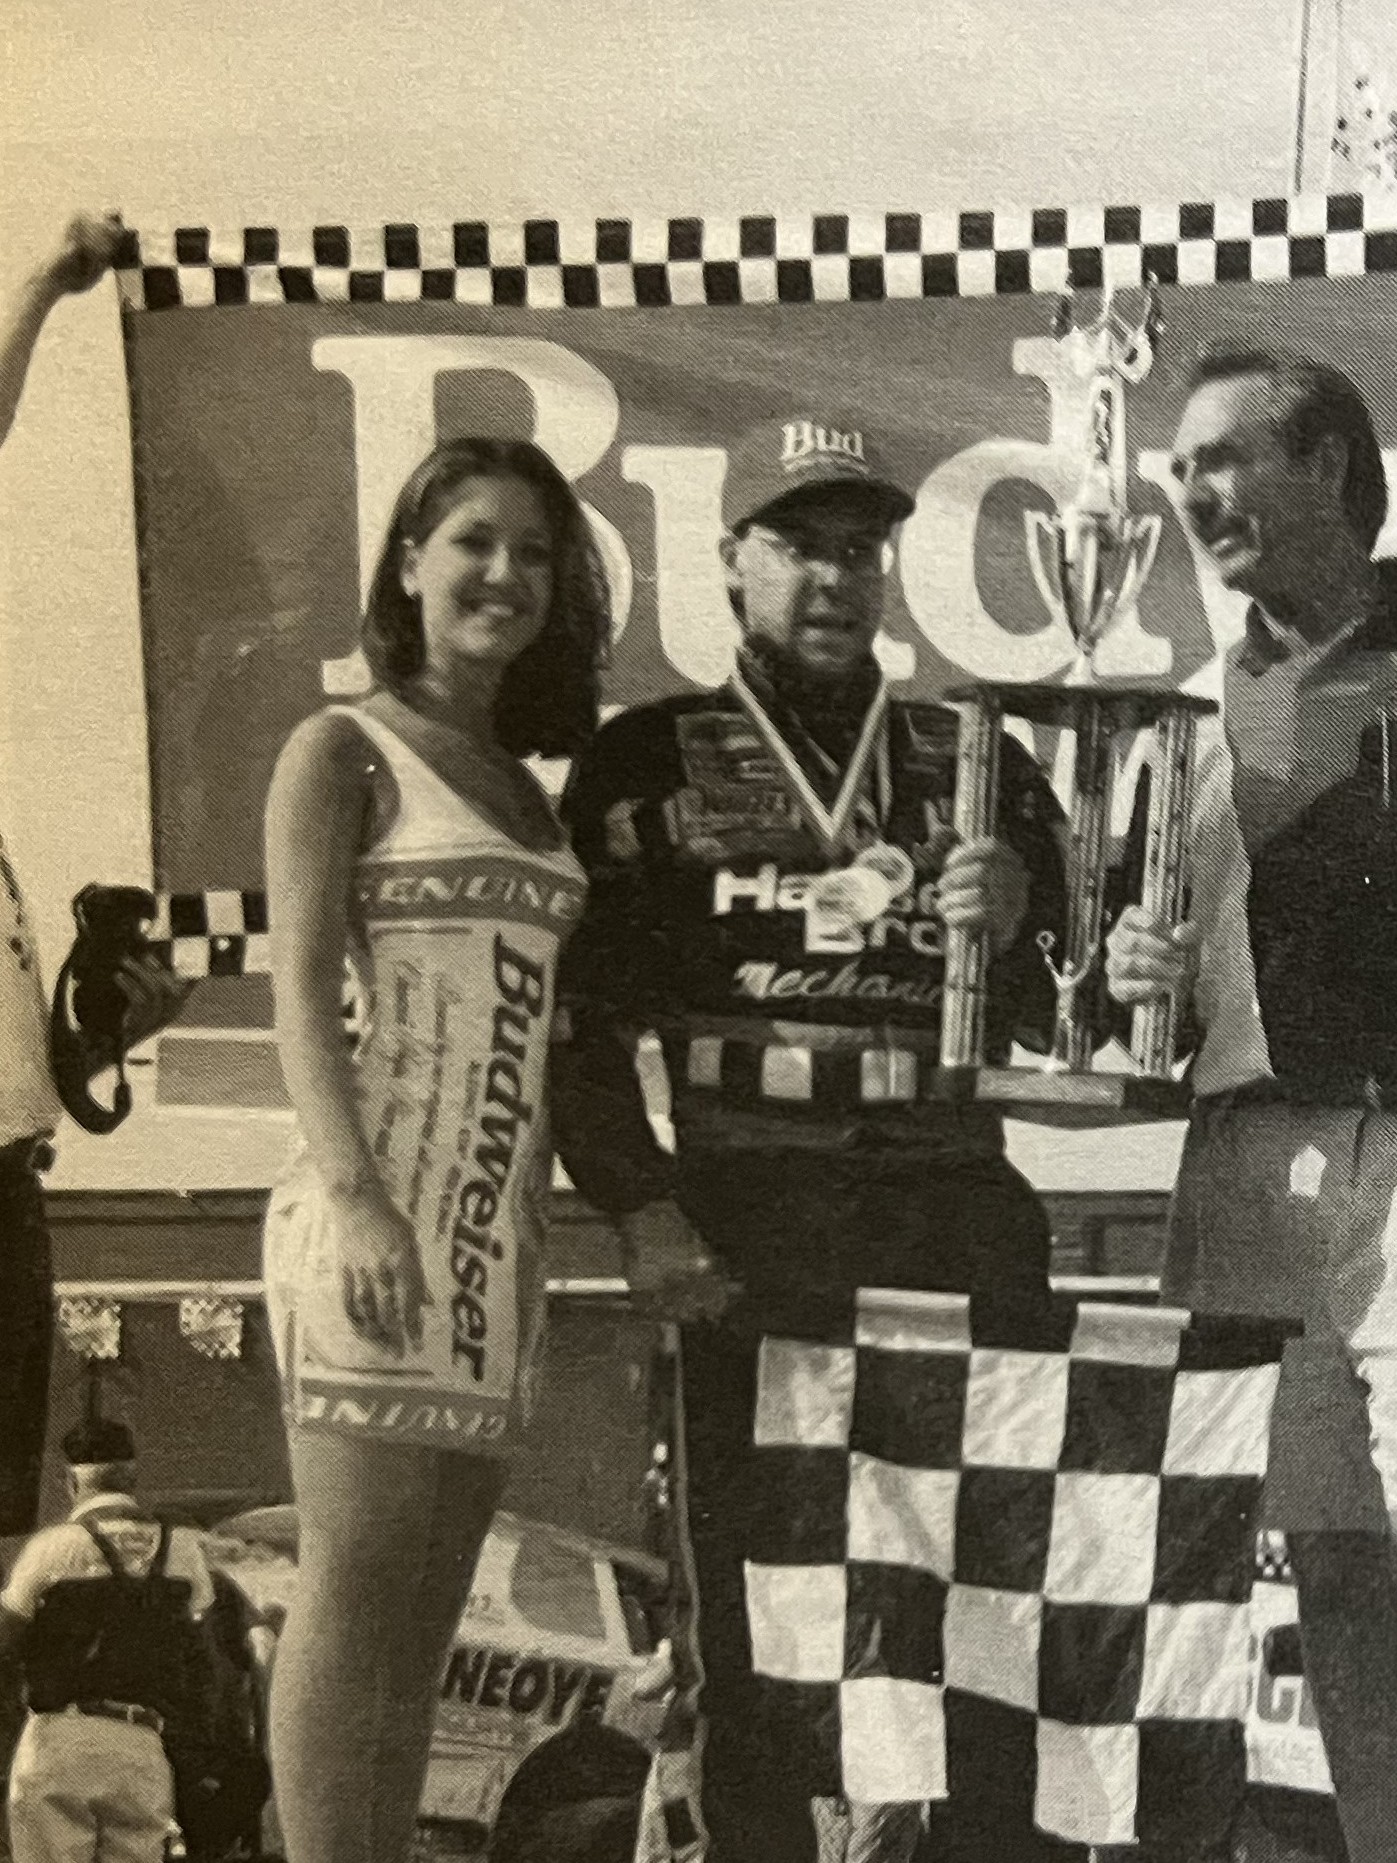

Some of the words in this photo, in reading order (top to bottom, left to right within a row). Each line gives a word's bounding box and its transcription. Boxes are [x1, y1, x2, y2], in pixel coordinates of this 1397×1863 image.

[779, 420, 865, 462] Bud
[358, 874, 584, 920] ENUINE
[449, 933, 546, 1382] Budweiser
